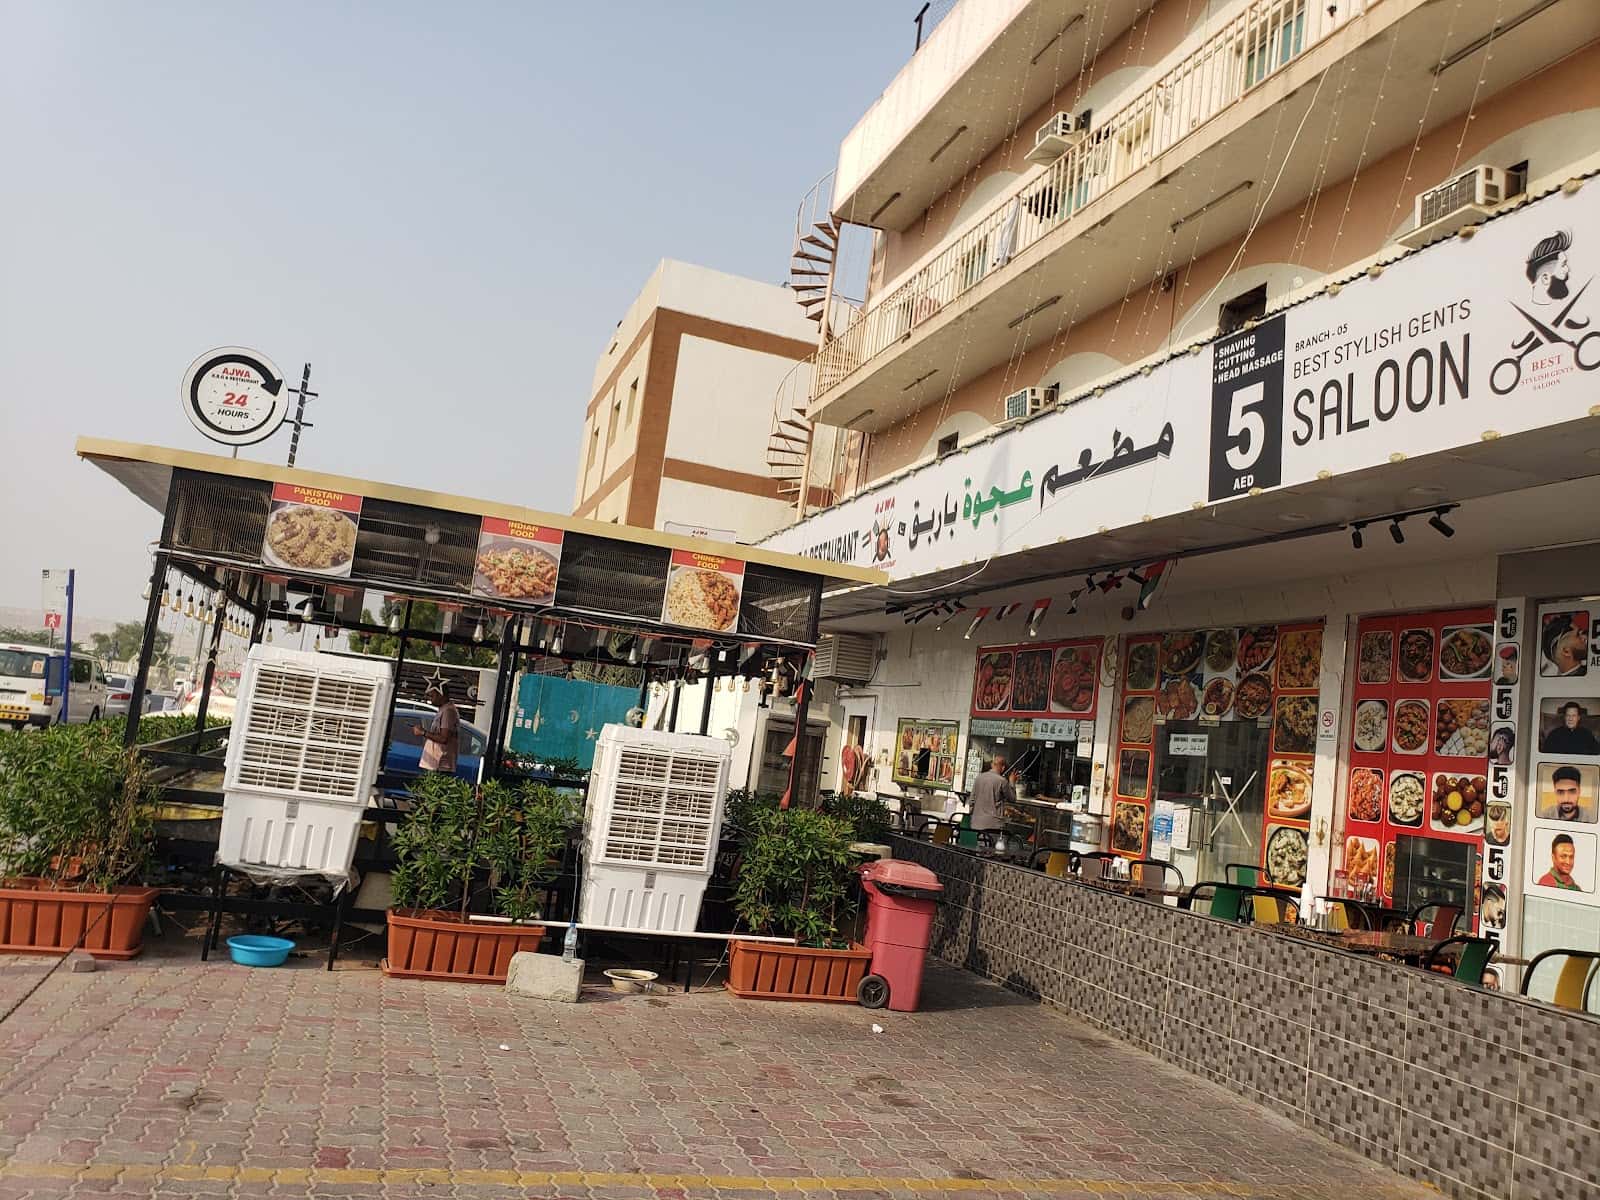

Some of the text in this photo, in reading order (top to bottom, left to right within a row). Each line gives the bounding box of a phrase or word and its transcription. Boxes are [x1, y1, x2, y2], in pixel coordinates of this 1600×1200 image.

[1218, 334, 1256, 359] SHAVING
[1293, 299, 1471, 380] BEST STYLISH GENTS
[1295, 329, 1330, 352] BRANCH
[1337, 323, 1349, 336] 05
[1217, 350, 1284, 384] HEAD MASSAGE
[1218, 347, 1256, 371] CUTTING
[1532, 354, 1561, 372] BEST
[222, 367, 251, 379] AJWA
[222, 392, 249, 407] 24
[1292, 333, 1470, 446] SALOON
[216, 408, 250, 420] HOURS
[1225, 381, 1265, 471] 5
[1040, 421, 1175, 514] مطعم
[293, 487, 344, 502] PAKISTANI
[1232, 474, 1255, 491] AED
[303, 495, 331, 507] FOOD
[874, 496, 896, 514] AJWA
[963, 470, 1034, 530] عجوة
[508, 520, 539, 533] INDIAN
[510, 528, 535, 539] FOOD
[692, 552, 726, 564] CHINESE
[696, 560, 720, 570] FOOD
[1501, 607, 1517, 639] 5
[1496, 688, 1513, 720] 5
[1492, 766, 1509, 799] 5
[1488, 847, 1504, 881] 5
